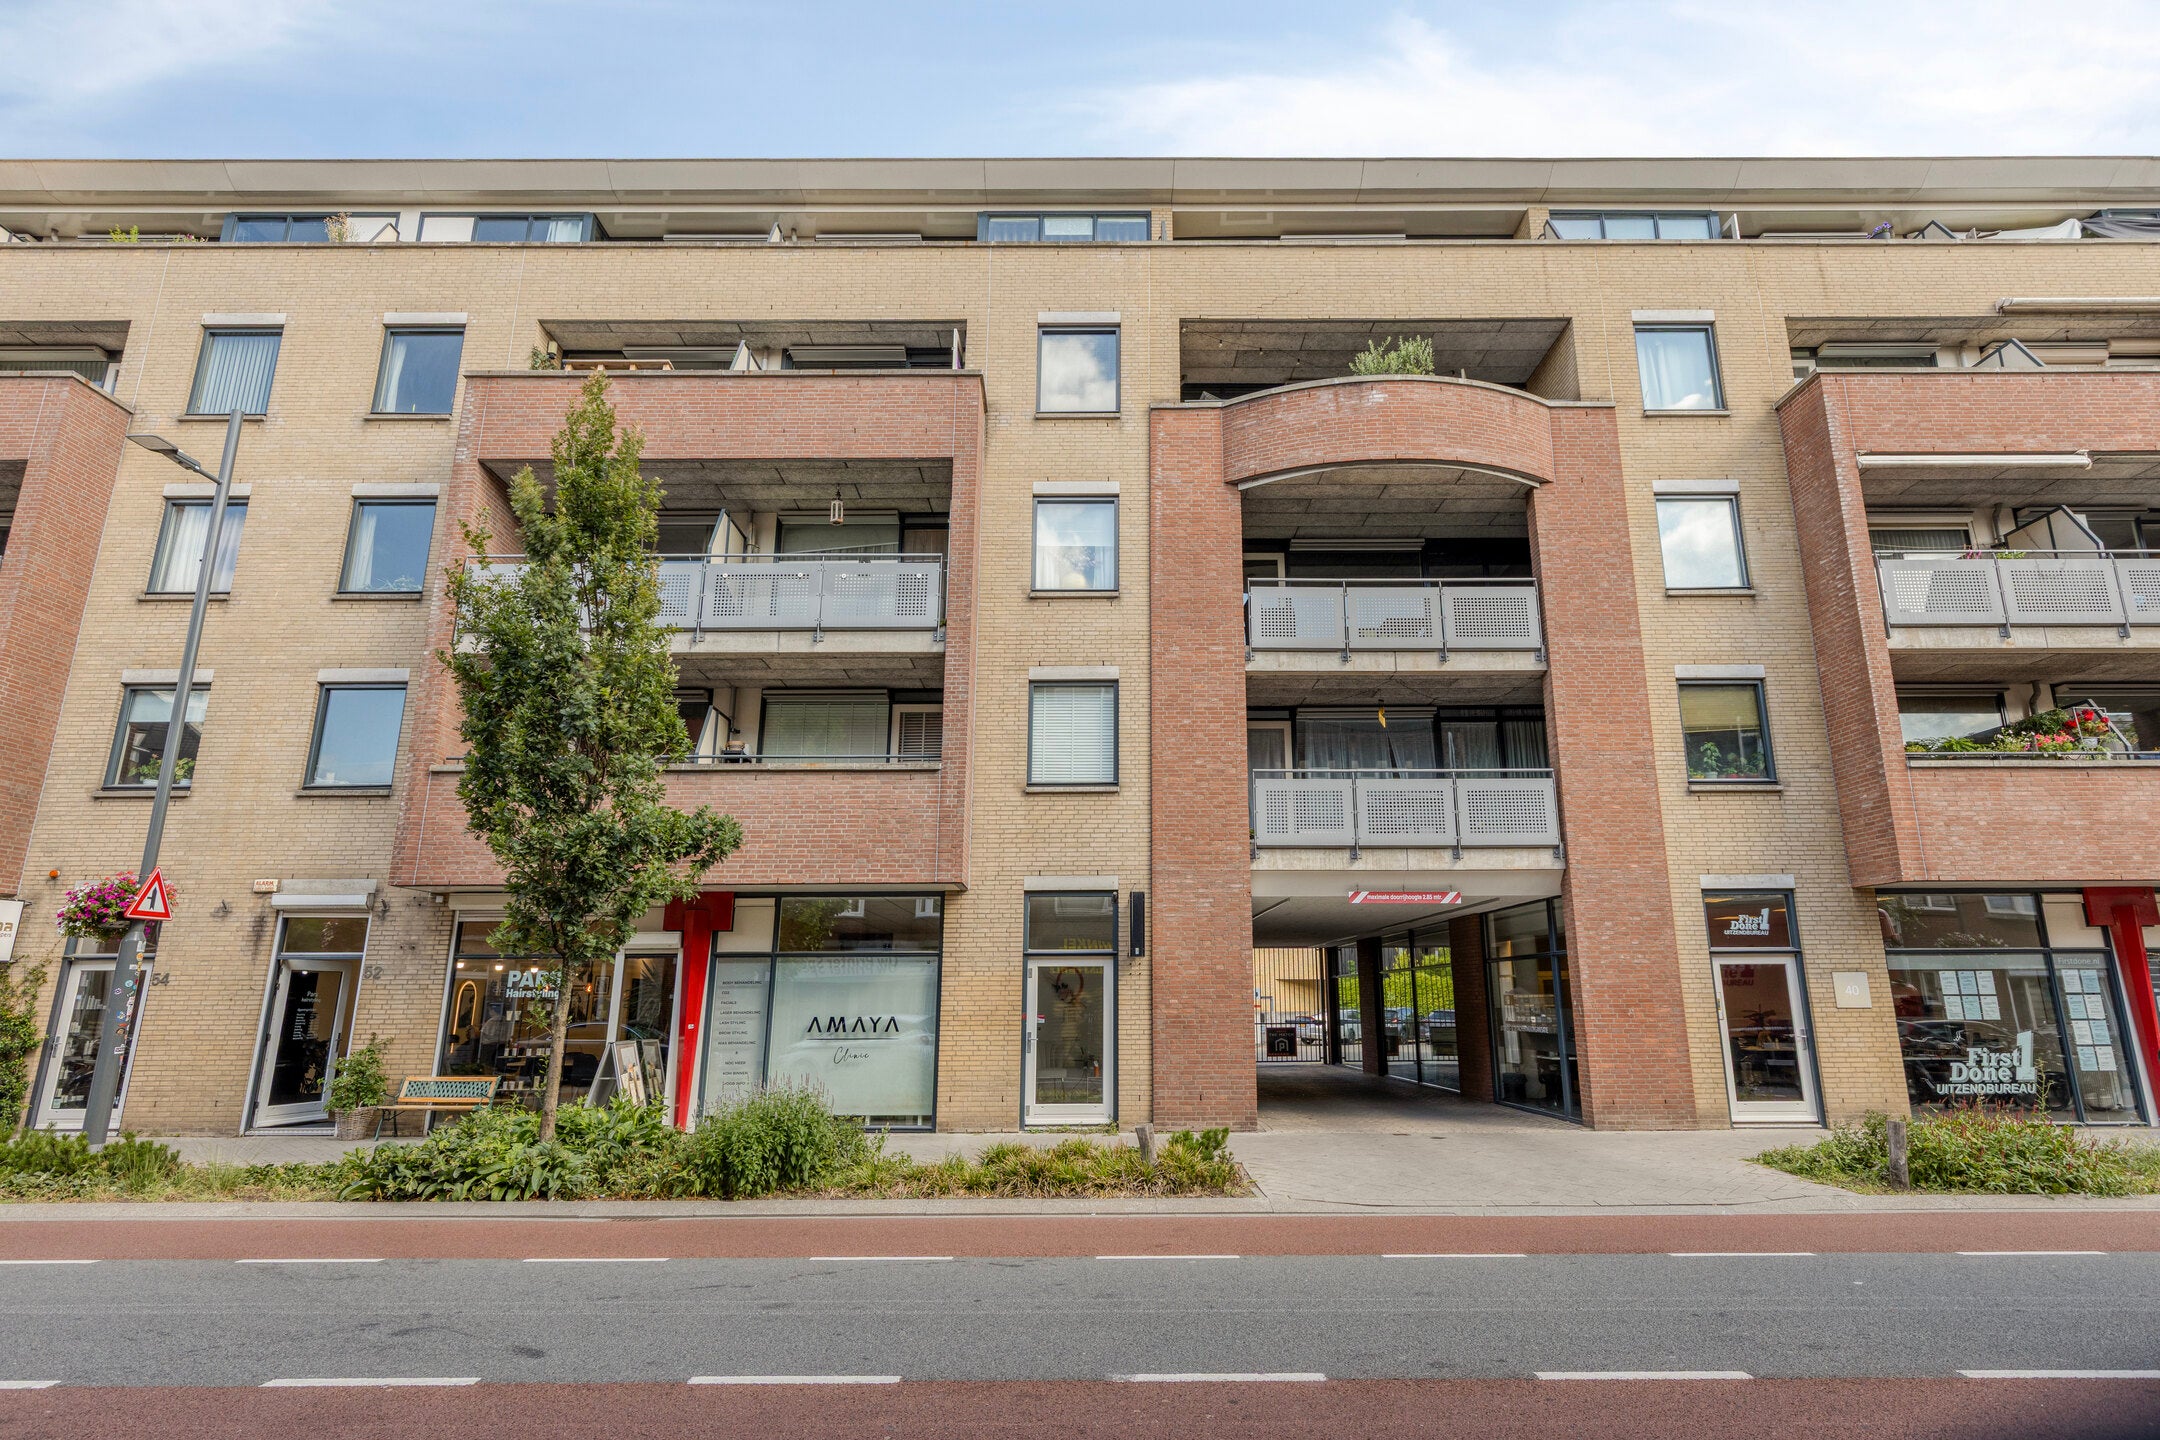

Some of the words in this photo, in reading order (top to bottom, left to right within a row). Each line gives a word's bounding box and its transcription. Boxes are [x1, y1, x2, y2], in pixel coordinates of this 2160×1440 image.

[1730, 921, 1759, 930] Done
[1738, 914, 1763, 924] First
[151, 972, 171, 987] 54
[362, 966, 383, 980] 52
[1845, 985, 1859, 996] 40
[806, 1016, 900, 1033] AMAYA
[833, 1046, 870, 1065] Clinic
[1966, 1046, 2021, 1069] First
[1950, 1062, 2013, 1083] Done
[1936, 1083, 2038, 1096] UITZENDBUREAU
